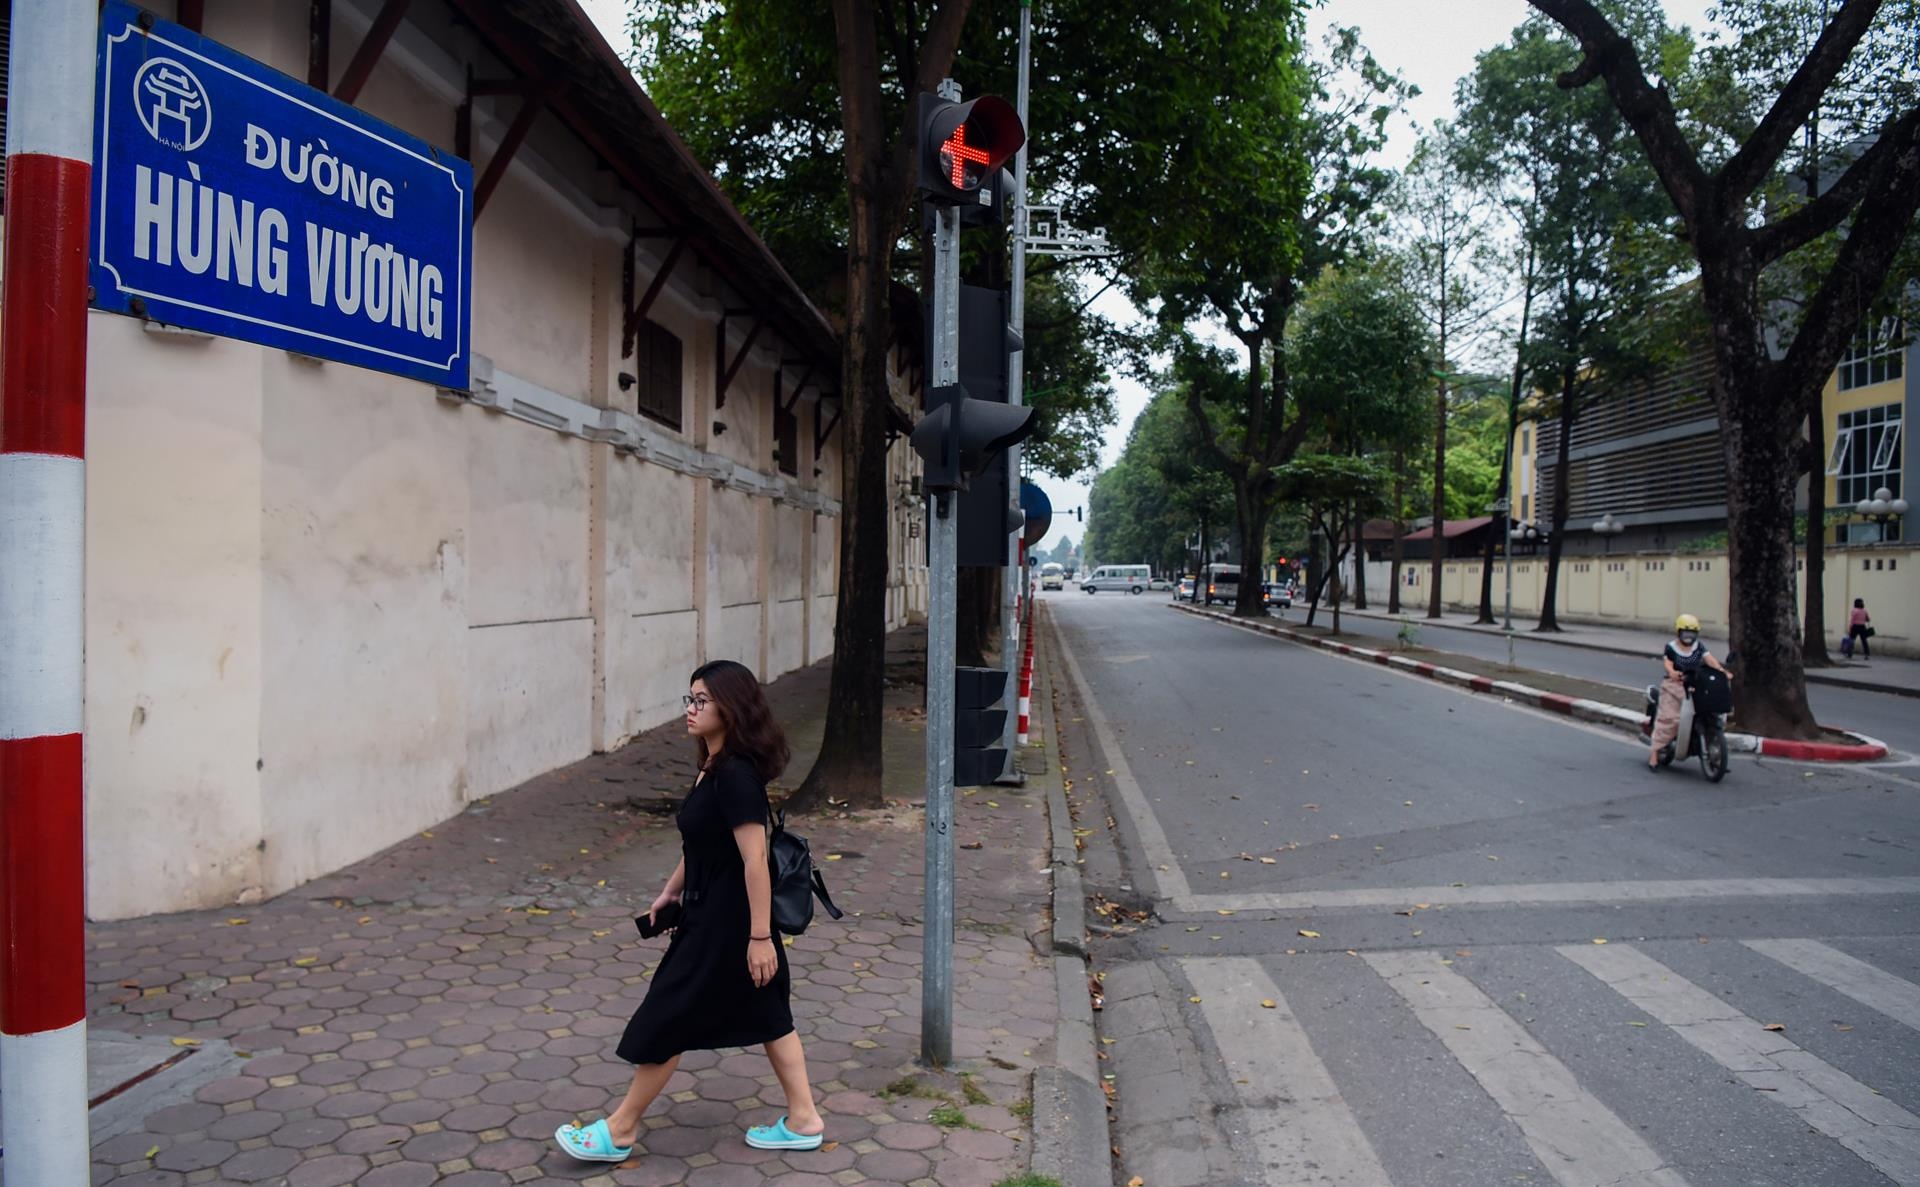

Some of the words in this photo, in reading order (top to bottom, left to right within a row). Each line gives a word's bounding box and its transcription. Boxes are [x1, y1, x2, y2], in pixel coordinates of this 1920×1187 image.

[243, 123, 394, 218] ĐƯỜNG
[134, 161, 289, 297] HÙNG
[305, 221, 443, 340] VƯƠNG
